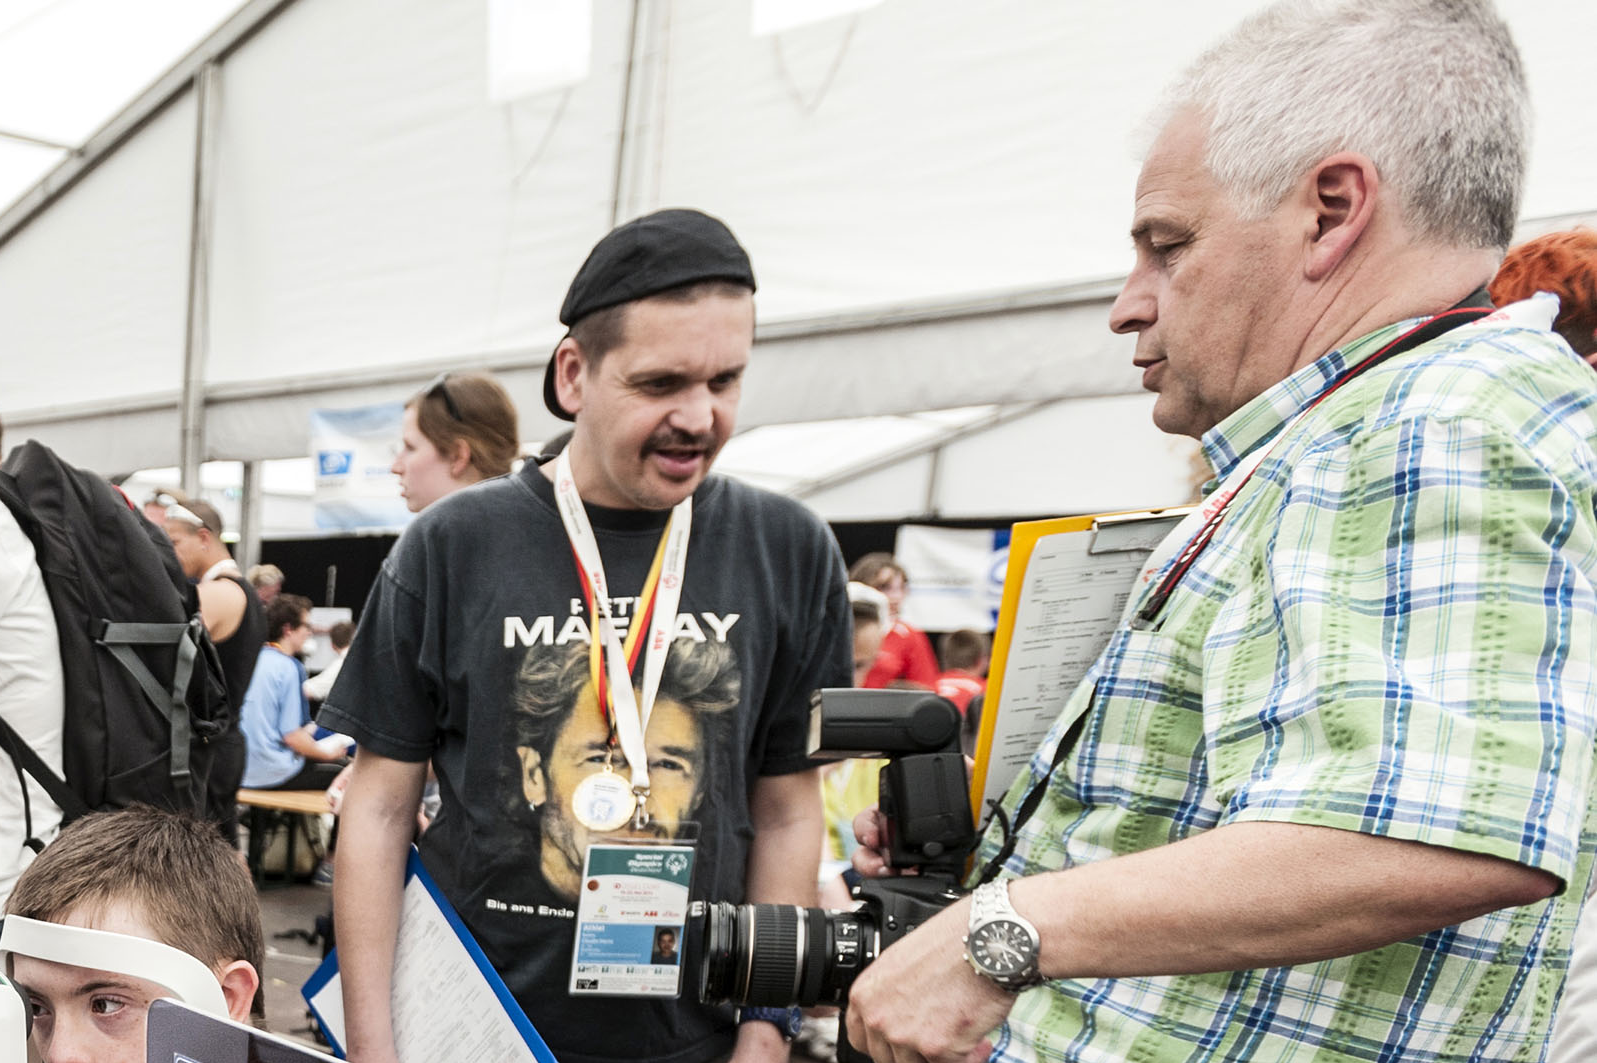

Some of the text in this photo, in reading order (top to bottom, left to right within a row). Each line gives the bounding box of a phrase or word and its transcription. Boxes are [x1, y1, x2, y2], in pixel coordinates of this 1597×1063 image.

[486, 898, 575, 919] Bis ans Ende
